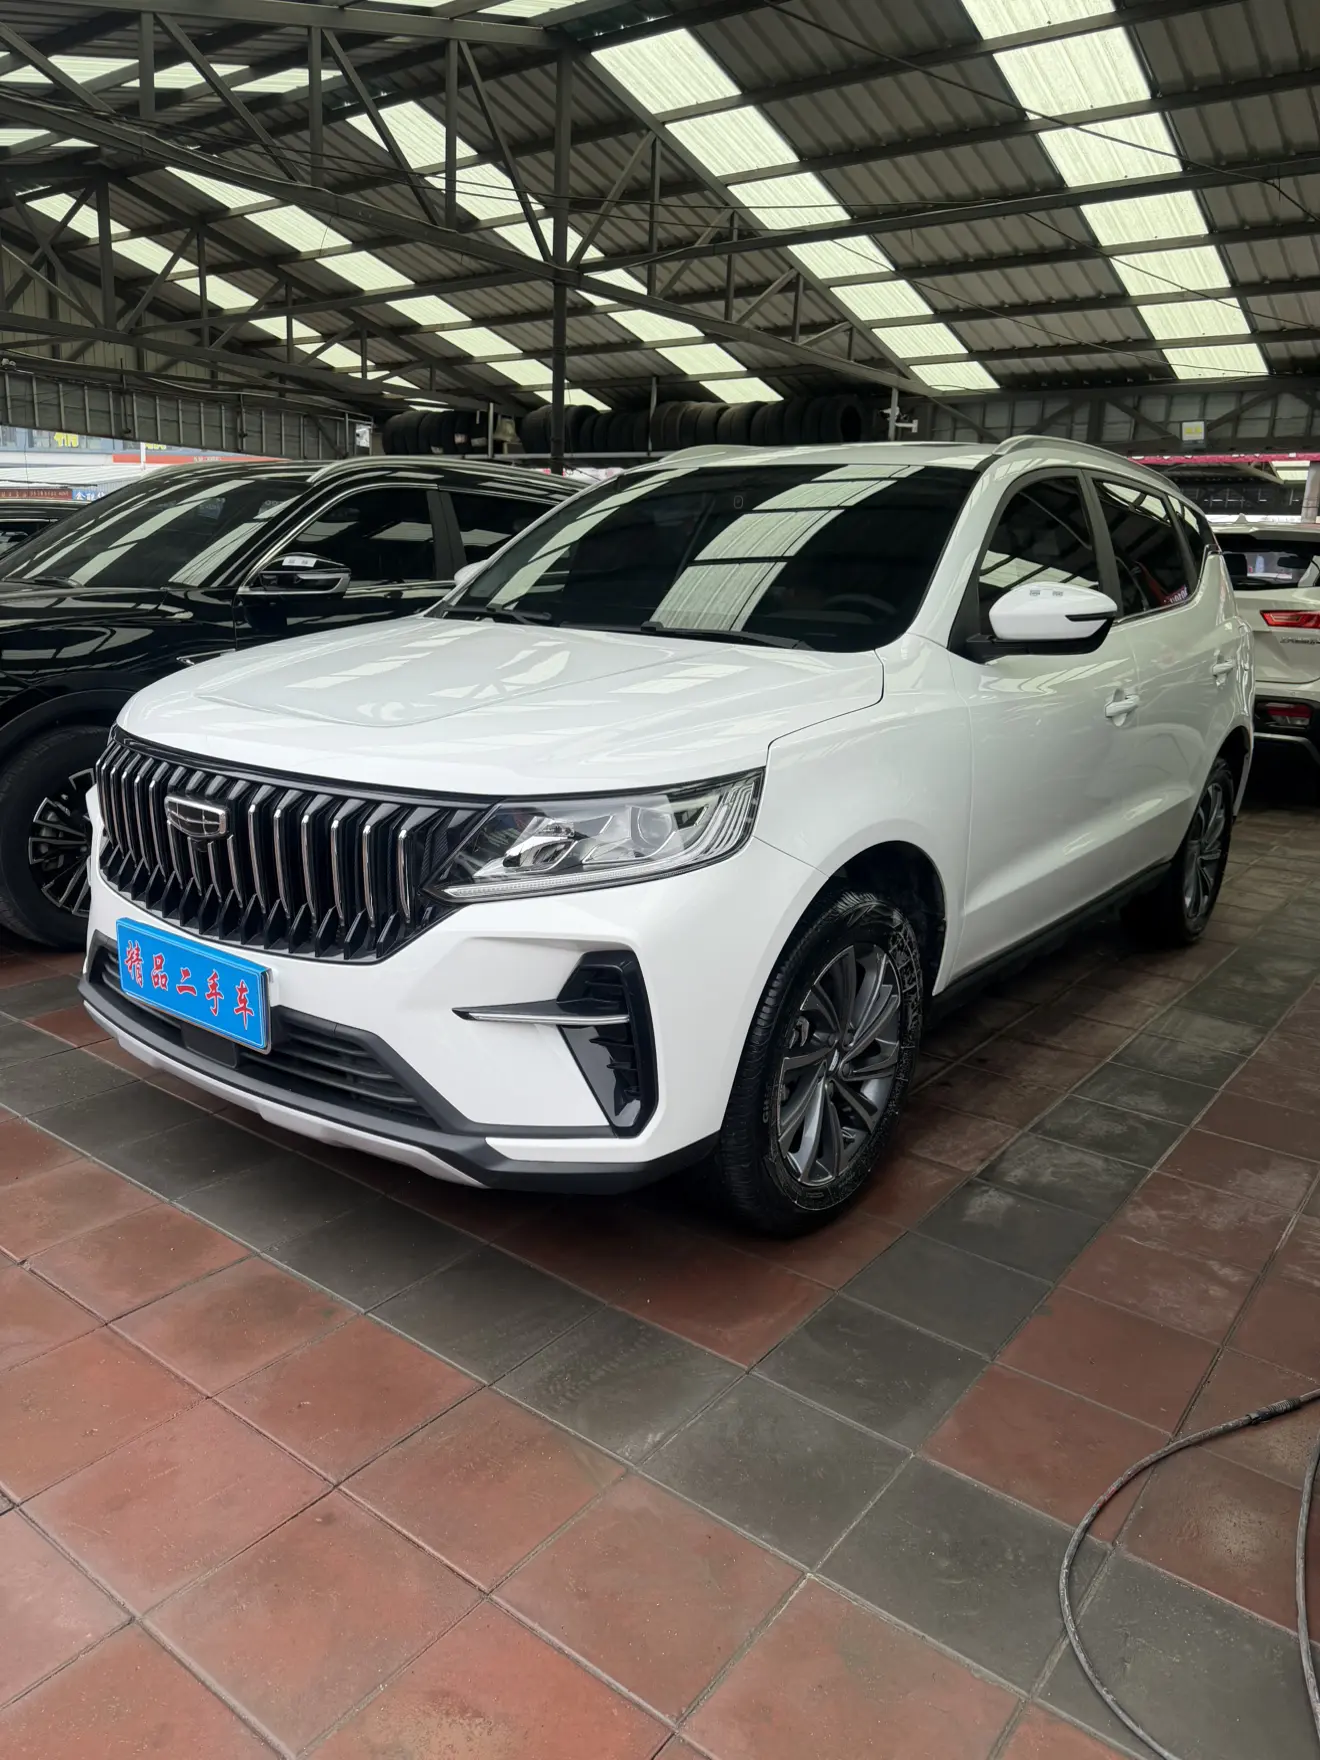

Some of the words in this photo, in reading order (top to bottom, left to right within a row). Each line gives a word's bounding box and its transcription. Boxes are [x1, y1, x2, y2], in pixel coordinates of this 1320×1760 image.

[124, 940, 255, 1030] 精品二手车
